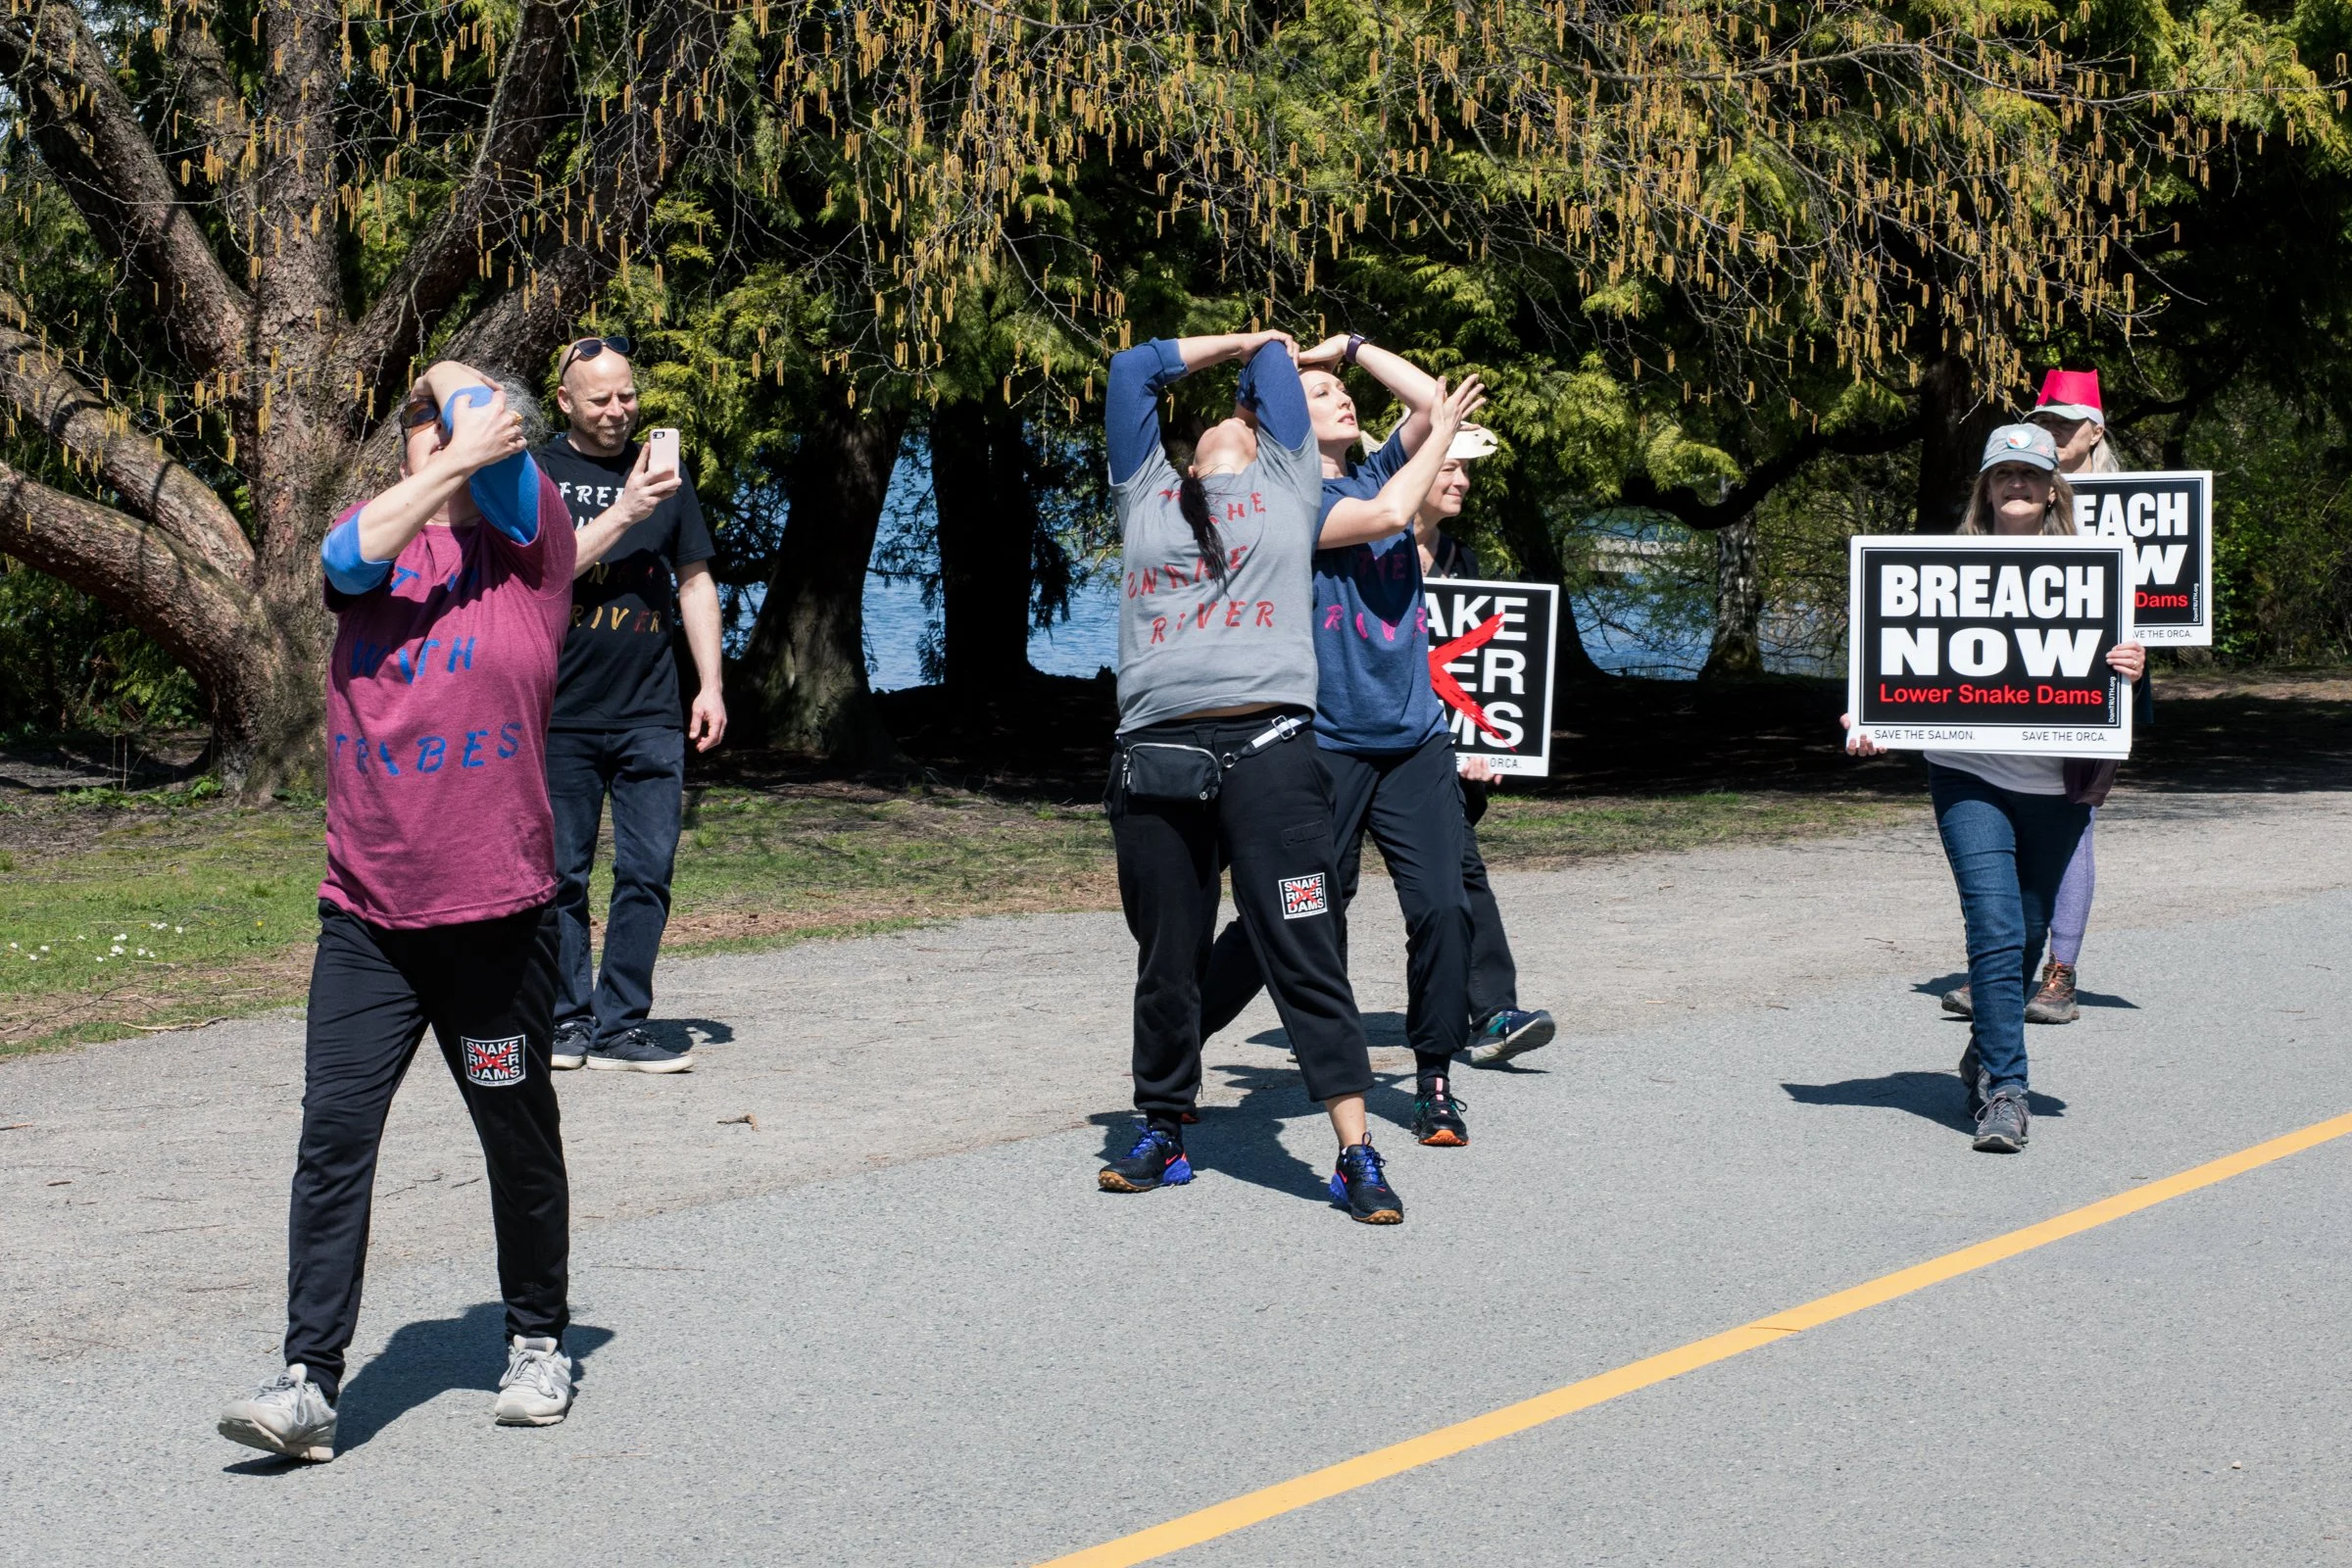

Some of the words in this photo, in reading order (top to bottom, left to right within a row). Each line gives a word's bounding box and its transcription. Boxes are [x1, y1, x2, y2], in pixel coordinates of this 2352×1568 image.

[2073, 492, 2188, 538] EACH
[1880, 564, 2104, 618] BREACH
[2135, 592, 2188, 608] Dams
[1424, 592, 1529, 642] AKE
[352, 636, 476, 685] WITH
[1880, 627, 2104, 677] NOW
[1880, 683, 1952, 704] Lower
[1958, 684, 2031, 705] Snake
[2036, 685, 2103, 705] Dams
[2108, 676, 2117, 723] DamTRUTH.org
[1875, 729, 1901, 739] SAVE
[1904, 730, 1925, 740] THE
[1927, 730, 1976, 741] SALMON.
[2022, 731, 2049, 741] SAVE
[2052, 731, 2073, 742] THE
[2076, 732, 2107, 743] ORCA.
[334, 721, 522, 776] TRIBES
[1490, 758, 1522, 769] ORCA.
[1284, 876, 1322, 892] SNAKE
[1287, 898, 1324, 913] DAMS
[466, 1040, 519, 1054] SNAKE
[469, 1065, 520, 1080] DAMS
